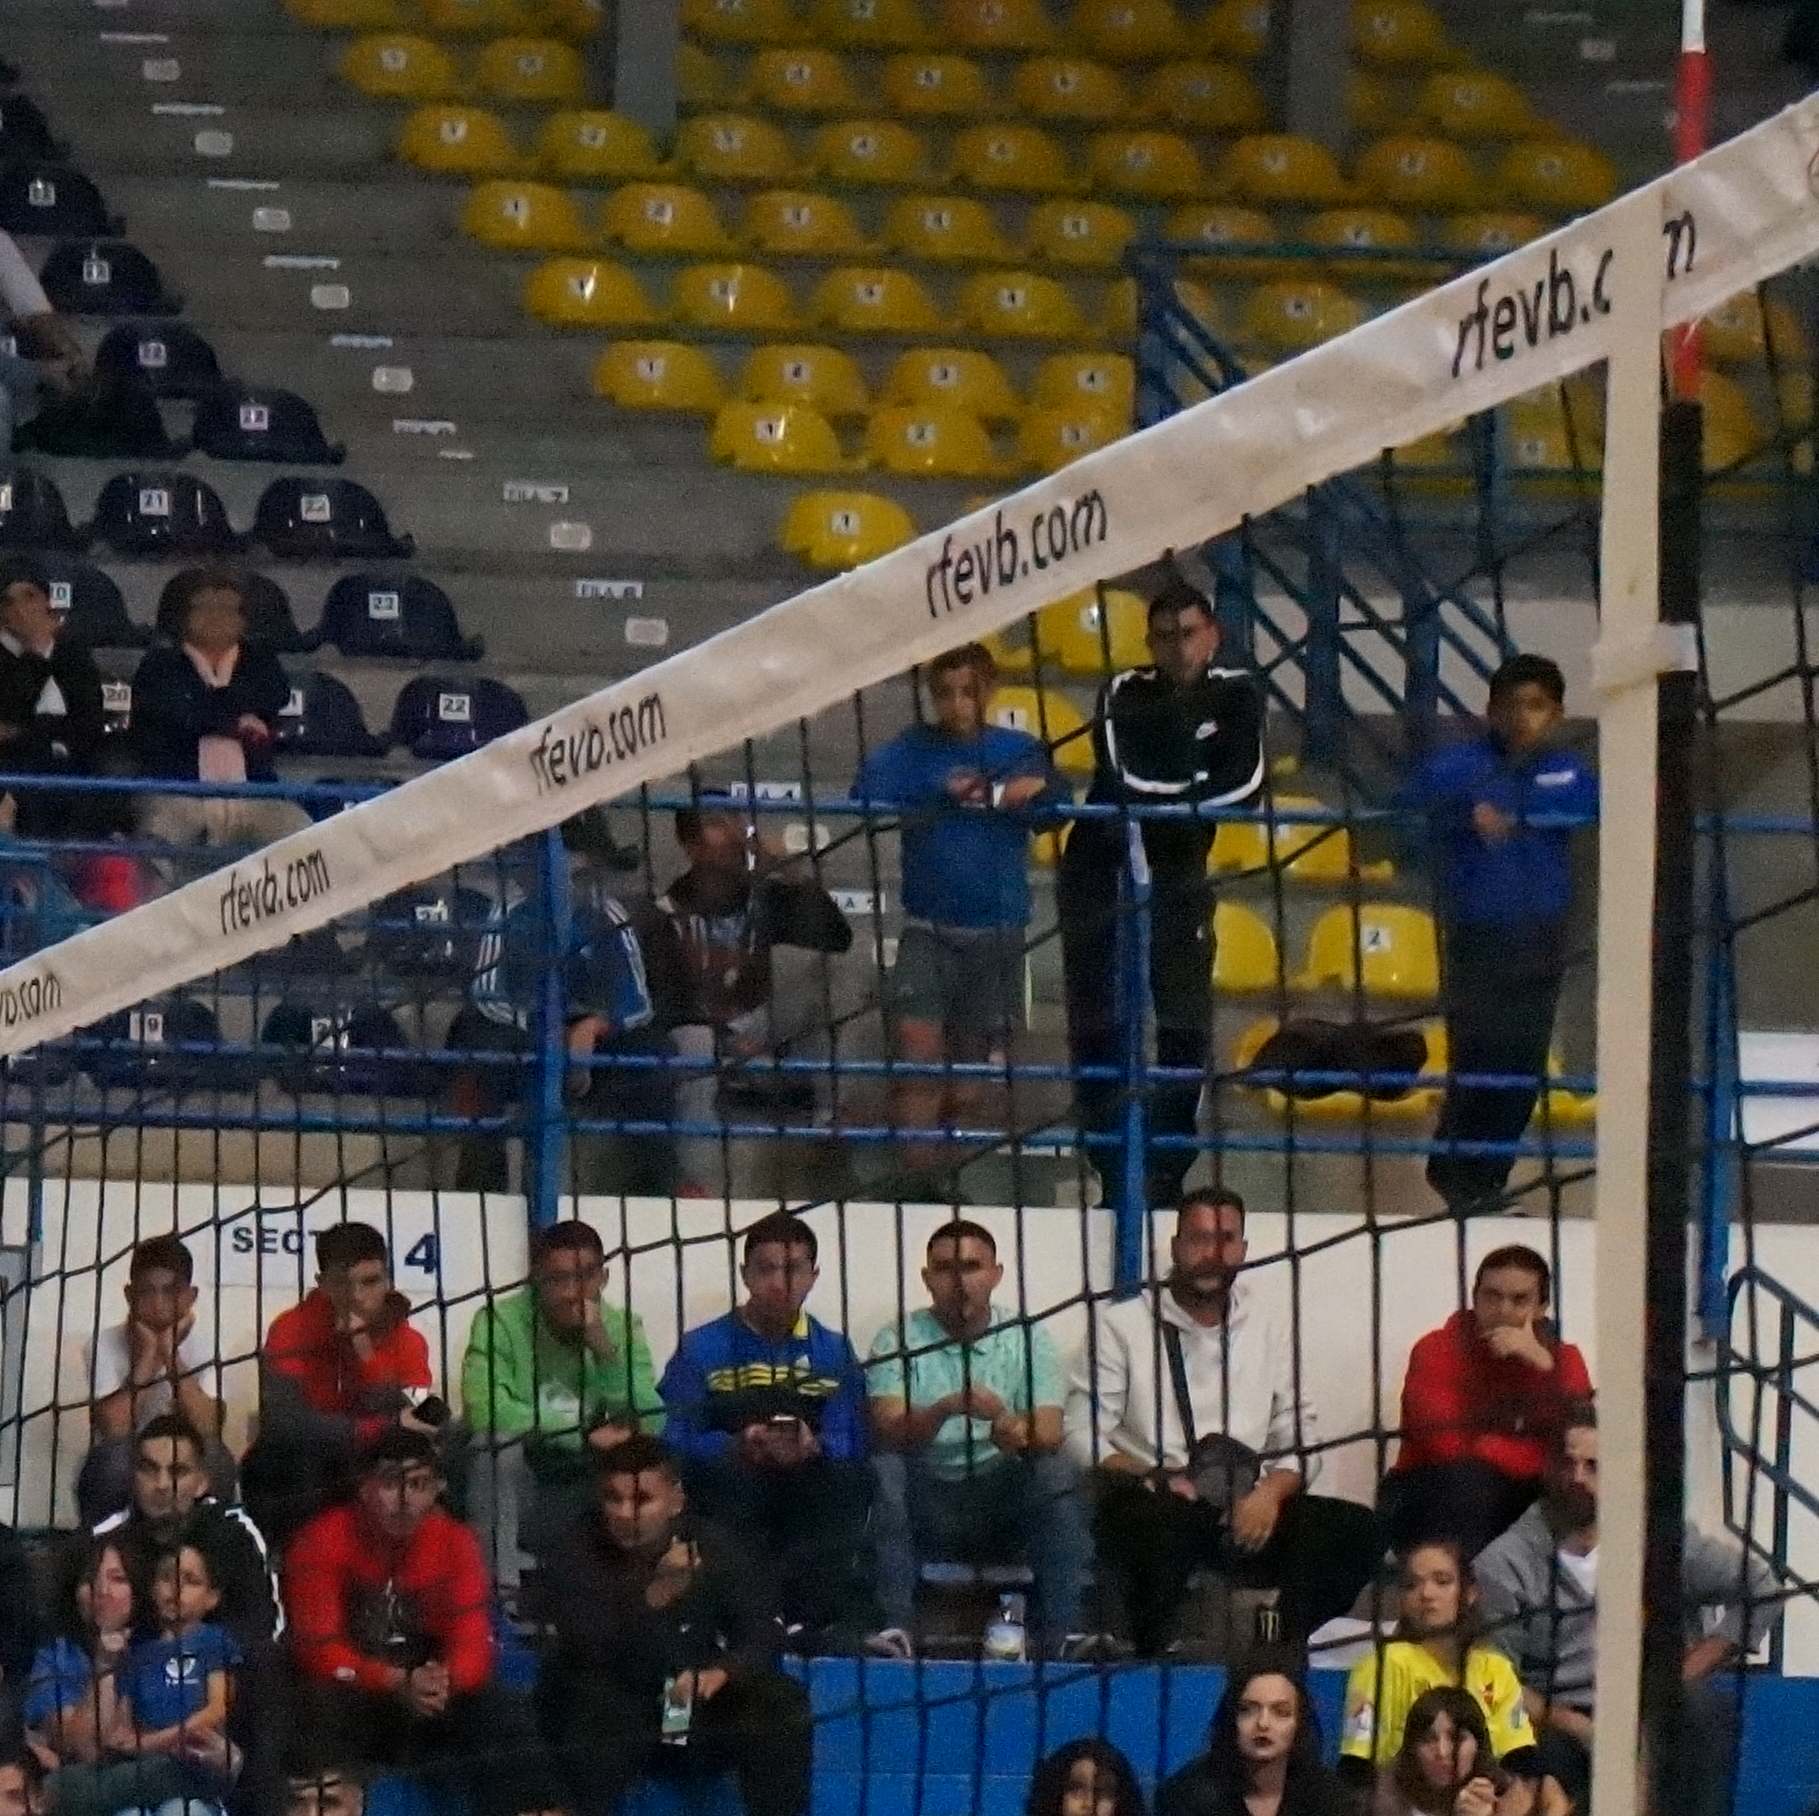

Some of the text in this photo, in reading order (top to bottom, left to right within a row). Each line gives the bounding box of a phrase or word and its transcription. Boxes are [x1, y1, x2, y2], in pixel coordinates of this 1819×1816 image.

[1452, 211, 1696, 378] rfevb.cm
[924, 487, 1108, 619] rfevb.com
[529, 692, 667, 797] rfevb.com
[404, 1233, 440, 1275] 4
